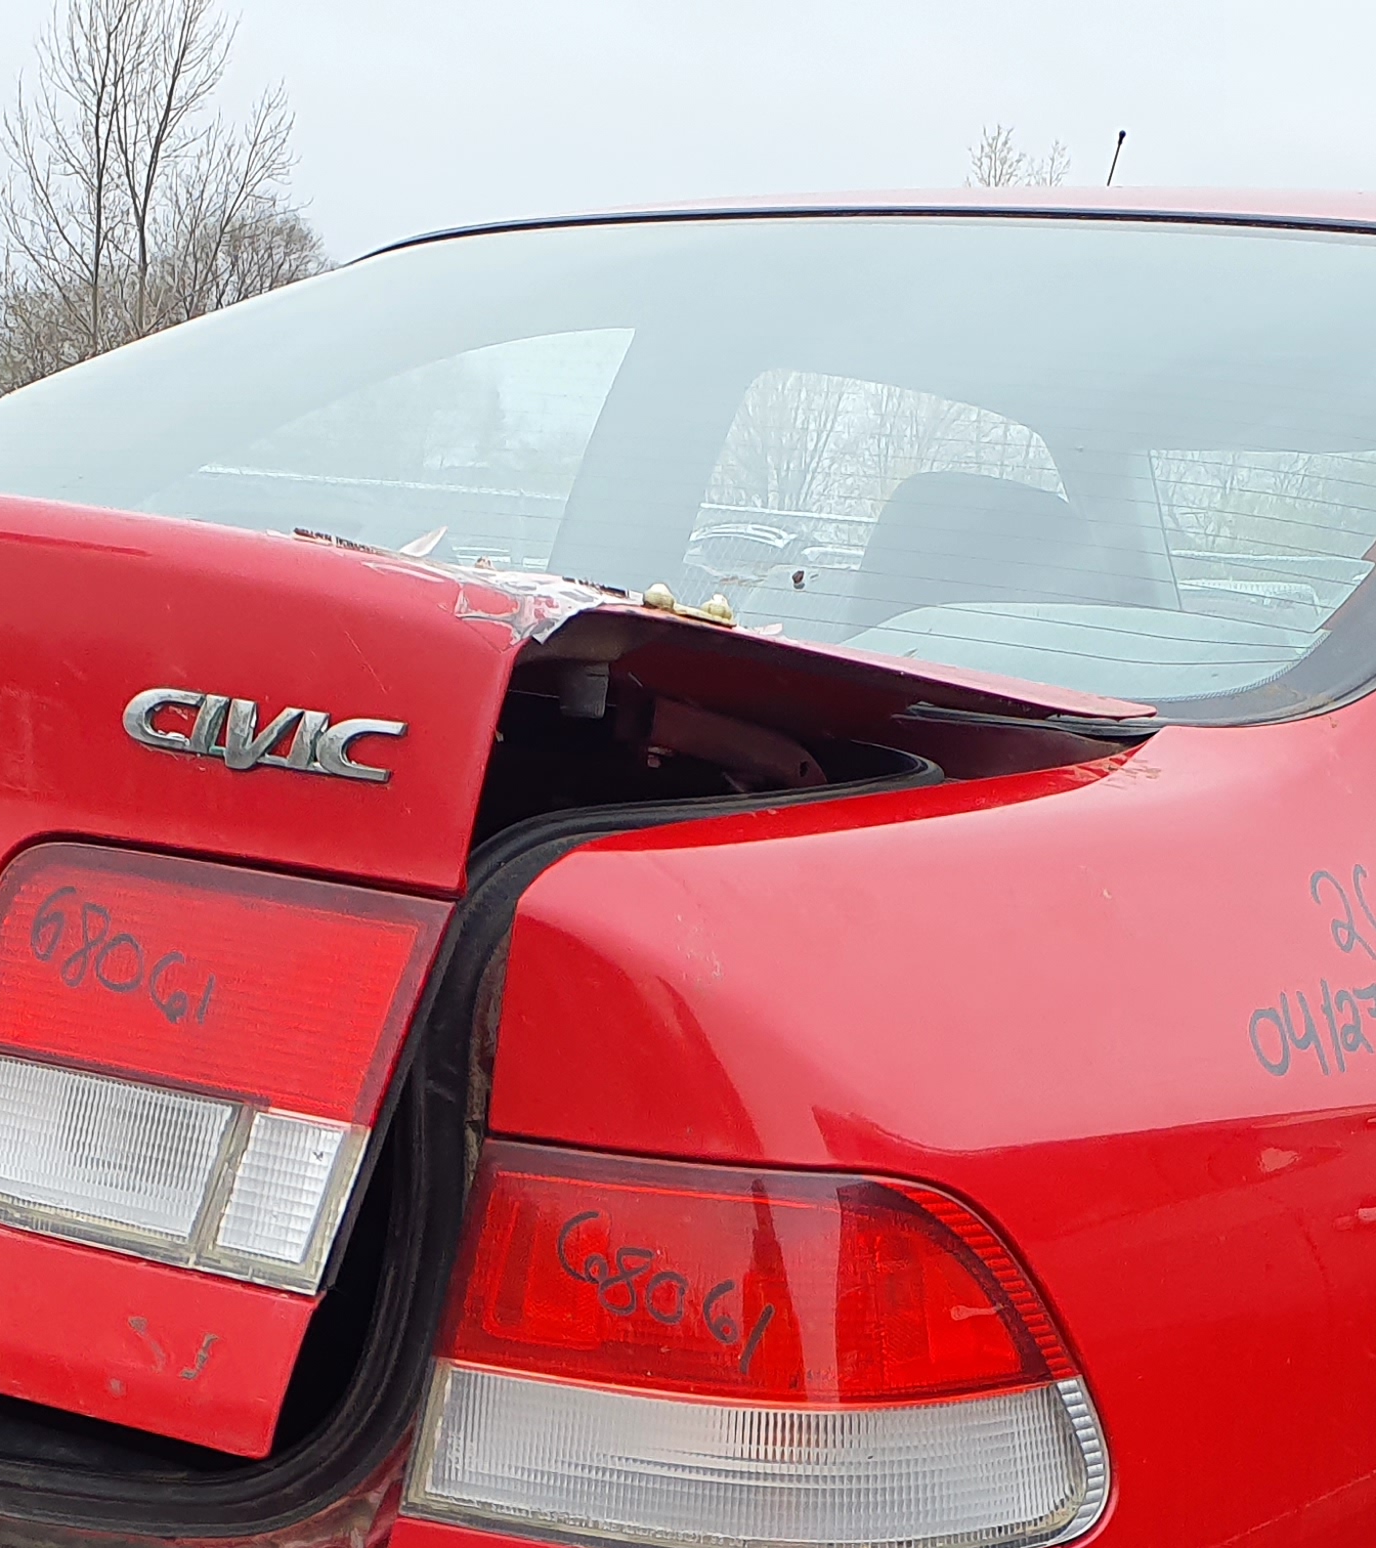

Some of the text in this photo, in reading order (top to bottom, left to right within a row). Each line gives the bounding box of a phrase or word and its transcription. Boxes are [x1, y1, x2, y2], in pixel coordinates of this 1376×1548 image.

[122, 687, 409, 783] CIVIC
[30, 885, 216, 1024] 68061
[556, 1210, 775, 1376] 68061
